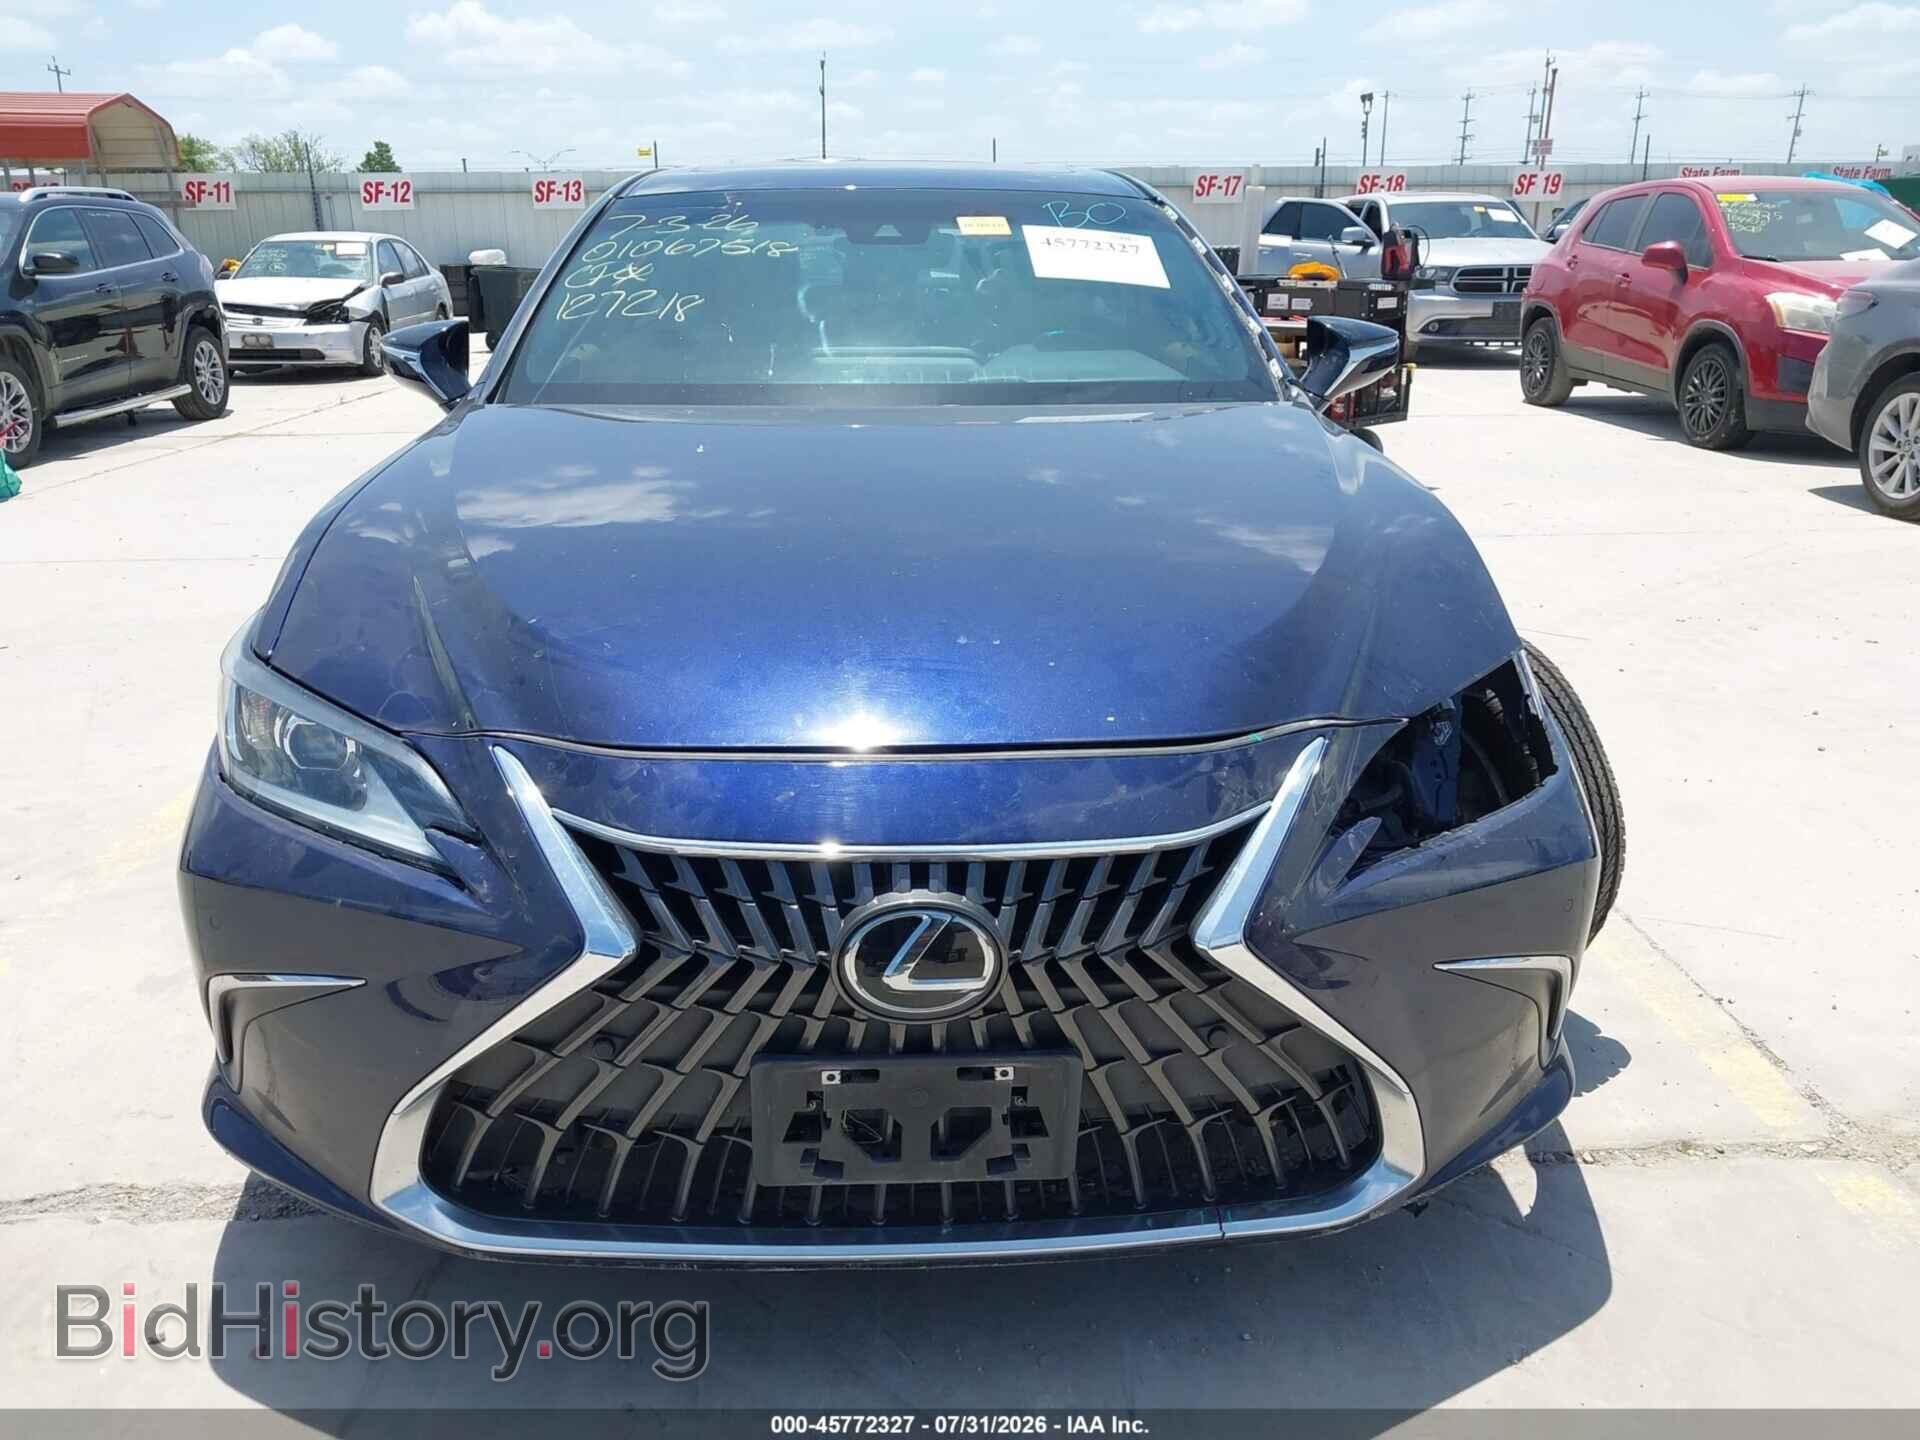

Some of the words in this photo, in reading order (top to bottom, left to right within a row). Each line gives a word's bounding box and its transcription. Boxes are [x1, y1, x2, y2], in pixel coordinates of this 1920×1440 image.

[1682, 166, 1710, 177] State
[1712, 166, 1741, 177] Farm
[1833, 166, 1861, 178] State
[1863, 165, 1892, 179] Farm
[185, 181, 231, 203] SF-11
[362, 180, 411, 203] SF-12
[534, 180, 582, 203] SF-13
[1195, 174, 1243, 197] SF-17
[1358, 174, 1405, 194] SF-18
[1514, 174, 1537, 195] SF
[1542, 173, 1563, 195] 19
[1040, 237, 1140, 255] 45772327
[556, 290, 705, 322] 127218
